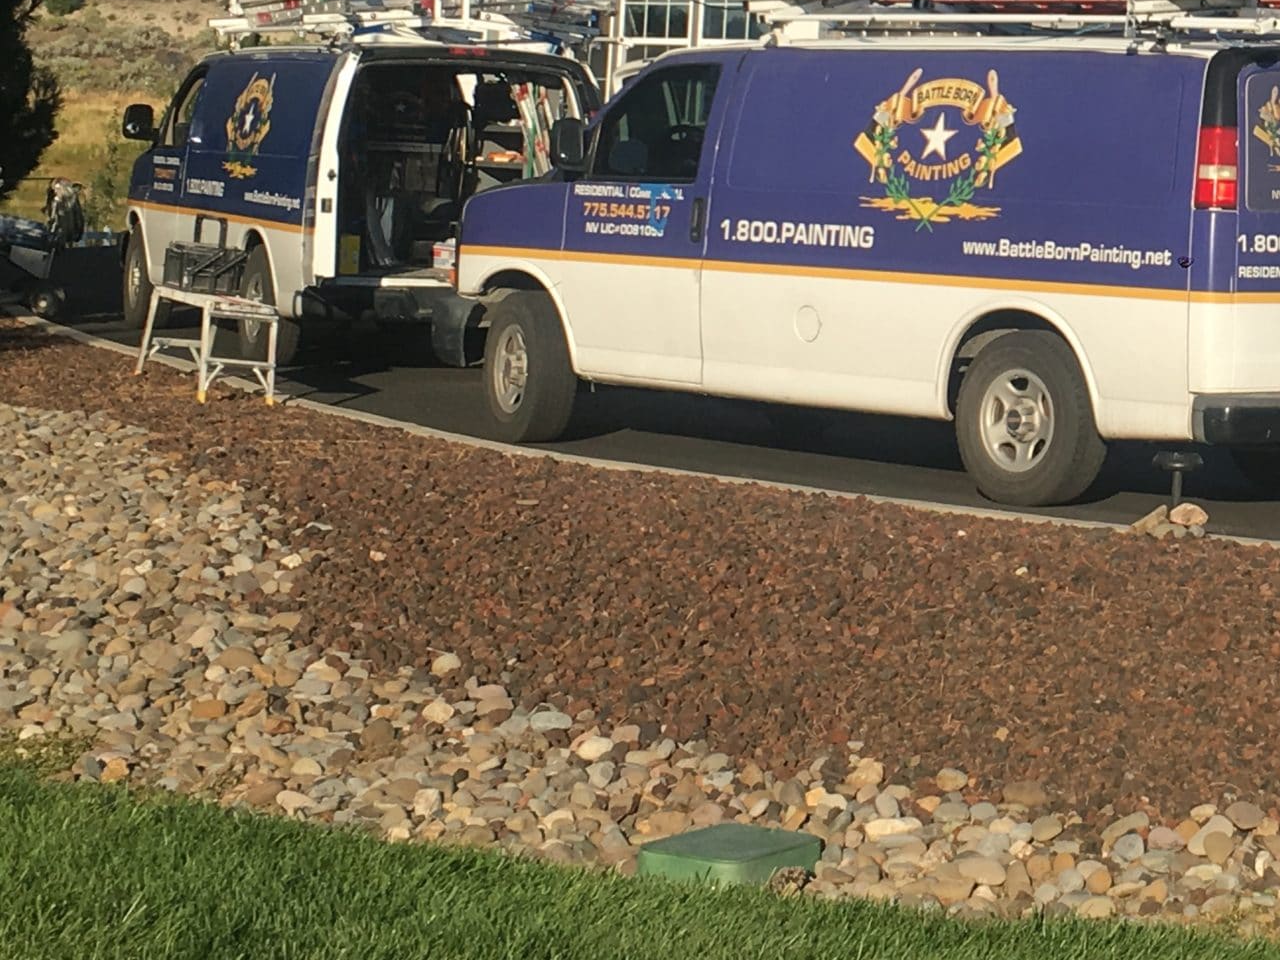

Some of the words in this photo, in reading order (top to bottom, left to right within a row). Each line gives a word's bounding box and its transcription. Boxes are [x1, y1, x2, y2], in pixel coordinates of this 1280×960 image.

[917, 86, 953, 104] BATTLE
[952, 87, 978, 105] BORN
[897, 149, 971, 181] PAINTING
[574, 184, 625, 198] RESIDENTIAL
[583, 201, 671, 220] 775.544.5717
[585, 222, 599, 233] NV
[720, 219, 875, 249] 1.800.PAINTING
[962, 238, 1173, 270] www.BattleBornPainting.net
